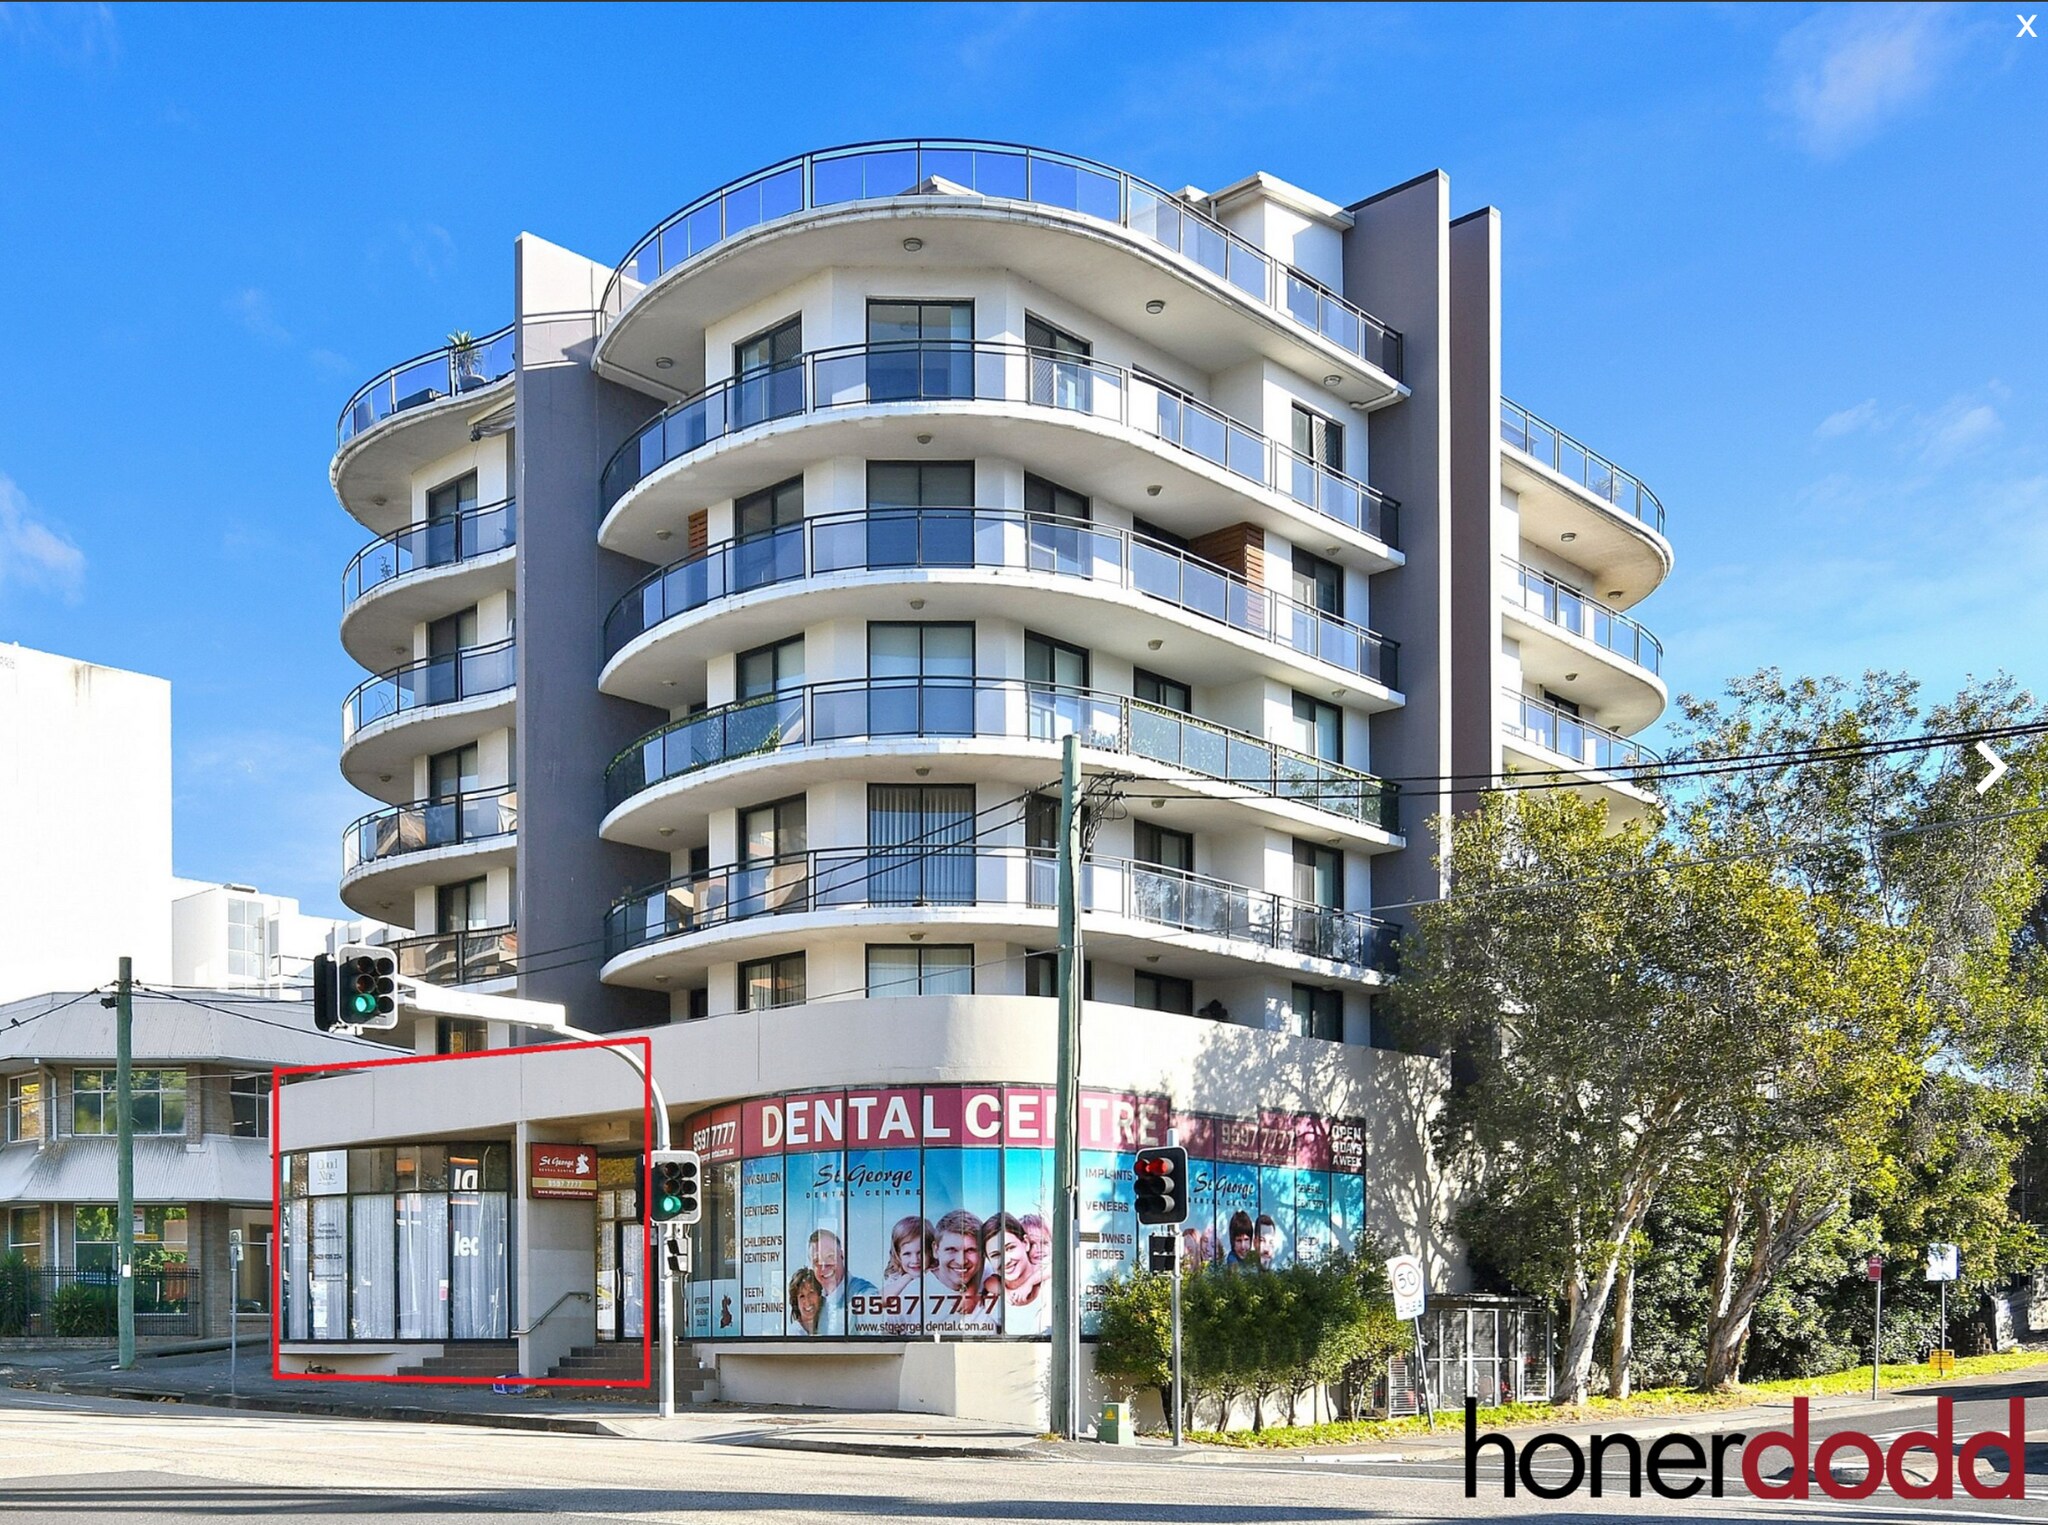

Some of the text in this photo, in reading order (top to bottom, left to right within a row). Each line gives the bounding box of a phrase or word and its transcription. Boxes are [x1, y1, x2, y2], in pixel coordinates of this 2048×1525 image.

[761, 1094, 1159, 1148] DENTAL CETRE
[711, 1121, 736, 1147] 7777
[1221, 1123, 1258, 1147] 9597
[1332, 1125, 1361, 1141] OPEN
[1340, 1141, 1363, 1155] DAYS
[539, 1156, 574, 1168] St George
[1332, 1155, 1362, 1168] A WEEK
[813, 1164, 913, 1188] St George
[1085, 1168, 1133, 1181] IMPLANTS
[1193, 1172, 1254, 1200] St George
[805, 1189, 923, 1199] DENTAL CENTRE
[744, 1204, 779, 1217] DENTURES
[1085, 1200, 1129, 1212] VENEERS
[744, 1235, 783, 1248] CHILDREN'S
[744, 1251, 780, 1263] DENTISTRY
[1086, 1249, 1125, 1261] BRIDGES
[744, 1287, 764, 1298] TEETH
[744, 1302, 785, 1313] WHITENING
[851, 1295, 920, 1315] 9597
